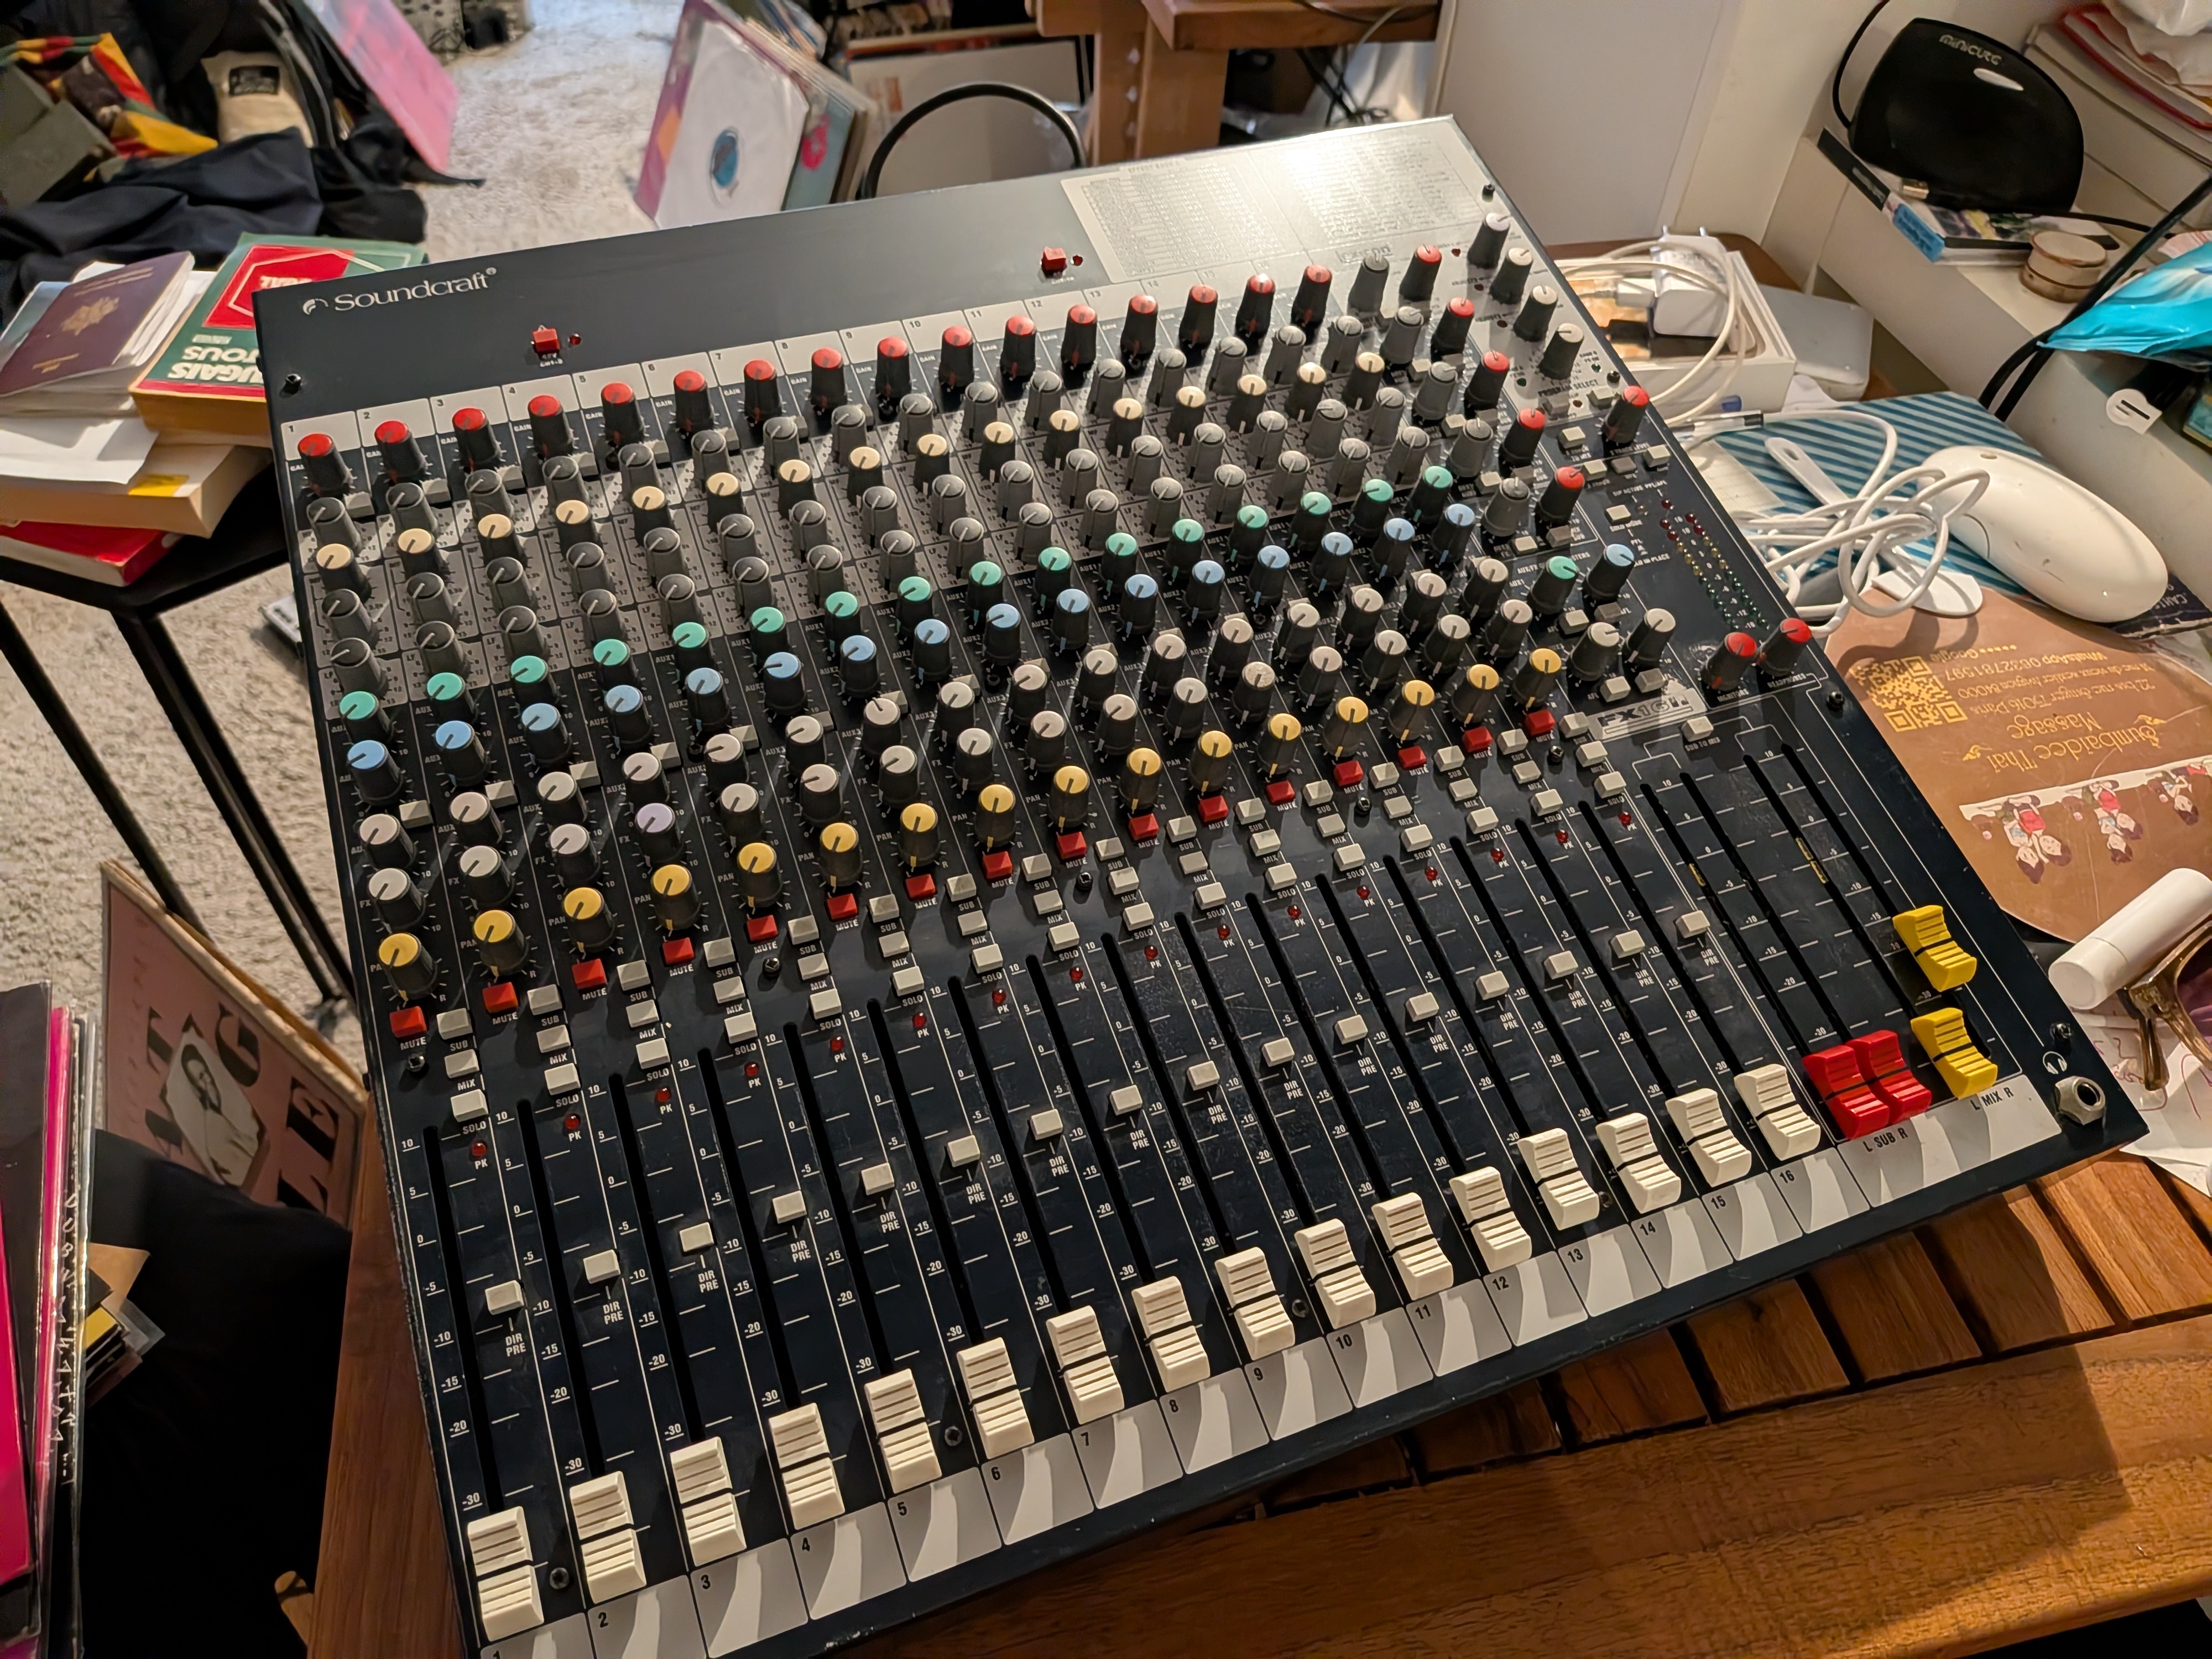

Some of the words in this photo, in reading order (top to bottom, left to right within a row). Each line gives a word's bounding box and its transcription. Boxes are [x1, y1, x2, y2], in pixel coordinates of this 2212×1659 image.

[335, 272, 489, 311] Soundcraft
[910, 320, 921, 328] 10
[168, 362, 263, 384] UGAIS
[2006, 712, 2103, 739] Massage
[1986, 749, 2038, 774] Thai
[1344, 784, 1364, 794] MUTE
[1383, 787, 1397, 796] SUB
[1026, 795, 1040, 803] PAN
[1399, 817, 1413, 826] MIX
[877, 833, 892, 841] PAN
[1138, 838, 1160, 849] MUTE
[1179, 842, 1194, 851] SUB
[1414, 850, 1432, 860] SOLO
[1193, 873, 1209, 883] MIX
[1432, 879, 1443, 887] PK
[915, 898, 938, 909] MUTE
[958, 901, 974, 911] SUB
[1207, 908, 1226, 919] SOLO
[1745, 915, 1757, 925] -10
[971, 935, 987, 946] MIX
[1223, 939, 1235, 948] PK
[1700, 949, 1714, 958] DIR
[1765, 946, 1777, 956] -15
[1704, 956, 1719, 966] PRE
[669, 964, 694, 977] MUTE
[716, 967, 733, 978] SUB
[982, 972, 1003, 983] SOLO
[1784, 977, 1796, 986] -20
[727, 1004, 744, 1015] MIX
[997, 1004, 1009, 1014] PK
[1500, 1013, 1514, 1022] DIR
[1503, 1020, 1519, 1030] PRE
[1814, 1027, 1827, 1036] -30
[400, 1036, 426, 1050] MUTE
[450, 1040, 468, 1051] SUB
[735, 1042, 757, 1055] SOLO
[458, 1079, 476, 1091] MIX
[749, 1078, 761, 1088] PK
[1284, 1081, 1298, 1091] DIR
[1286, 1088, 1303, 1099] PRE
[1970, 1099, 1980, 1110] L
[1981, 1092, 2003, 1107] MIX
[2005, 1087, 2014, 1098] R
[1406, 1100, 1420, 1110] -20
[496, 1112, 507, 1120] 10
[463, 1121, 487, 1134] SOLO
[1863, 1140, 1873, 1152] L
[1874, 1132, 1896, 1149] SUB
[1898, 1128, 1909, 1140] R
[474, 1159, 488, 1170] PK
[505, 1159, 511, 1167] 5
[1049, 1156, 1065, 1167] DIR
[1433, 1156, 1447, 1166] -30
[1051, 1164, 1070, 1176] PRE
[1083, 1166, 1097, 1175] -15
[1780, 1171, 1794, 1183] 16
[1712, 1196, 1725, 1208] 15
[514, 1205, 520, 1214] 0
[1641, 1222, 1655, 1235] 14
[791, 1240, 807, 1252] DIR
[523, 1251, 534, 1260] -5
[792, 1249, 811, 1262] PRE
[1568, 1249, 1583, 1262] 13
[1119, 1265, 1134, 1275] -30
[1493, 1277, 1509, 1290] 12
[533, 1300, 549, 1311] -10
[1416, 1305, 1430, 1319] 11
[505, 1333, 523, 1346] DIR
[1337, 1334, 1352, 1349] 10
[506, 1343, 526, 1357] PRE
[541, 1343, 557, 1354] -15
[1254, 1368, 1262, 1380] 9
[551, 1386, 567, 1399] -20
[1170, 1400, 1178, 1412] 8
[1081, 1432, 1088, 1446] 7
[565, 1458, 582, 1470] -30
[992, 1467, 1000, 1480] 6
[898, 1502, 906, 1515] 5
[802, 1538, 810, 1551] 4
[701, 1575, 710, 1589] 3
[598, 1613, 608, 1627] 2
